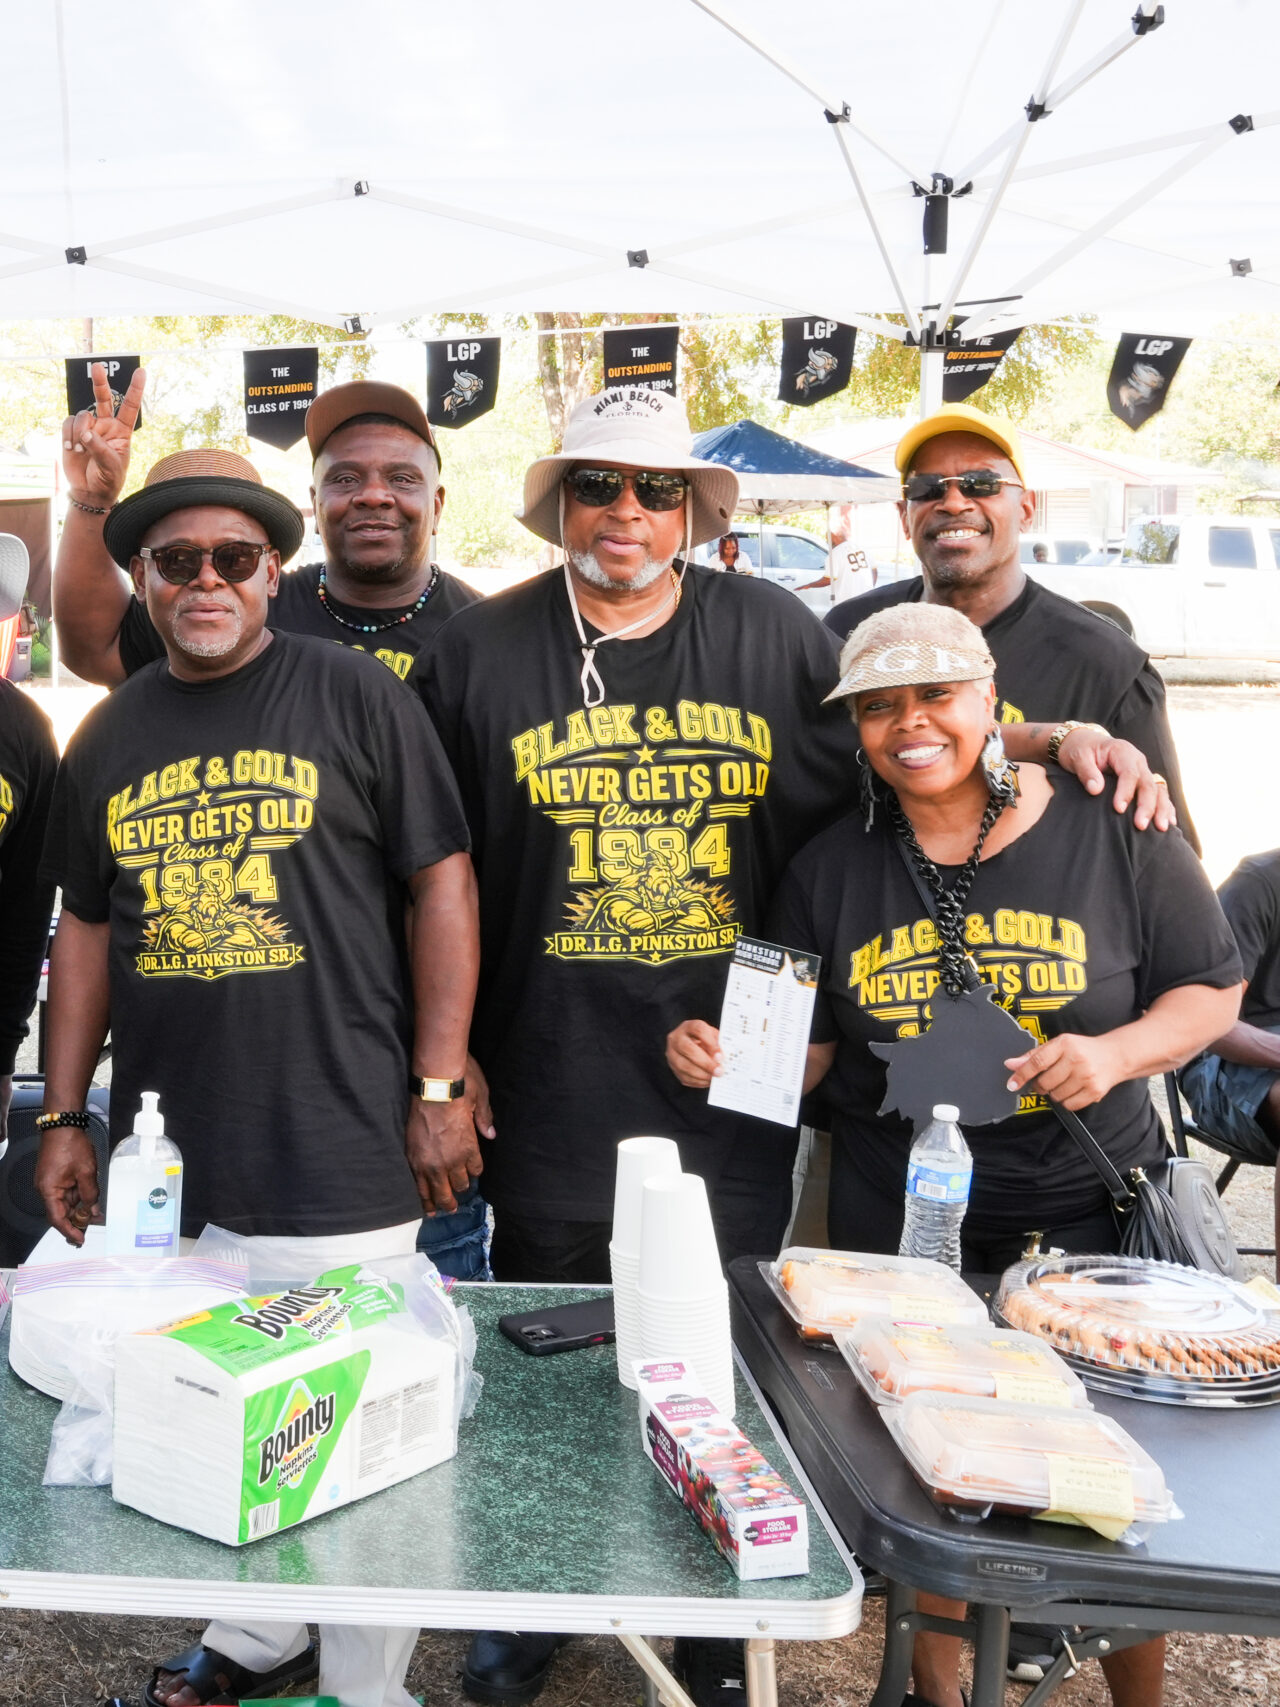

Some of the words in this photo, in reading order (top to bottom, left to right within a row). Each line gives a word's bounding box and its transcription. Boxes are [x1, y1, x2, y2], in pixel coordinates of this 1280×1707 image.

[803, 320, 838, 340] LGP
[447, 342, 481, 362] LGP
[631, 346, 650, 358] THE
[1134, 338, 1173, 356] LGP
[271, 367, 290, 377] THE
[608, 361, 672, 378] OUTSTANDING
[248, 382, 313, 396] OUTSTANDING
[651, 379, 673, 390] 1984
[247, 402, 277, 415] CLASS
[278, 401, 291, 411] OF
[593, 391, 623, 416] MIAMI
[629, 391, 664, 412] BEACH
[847, 550, 868, 572] 93
[512, 704, 639, 783] BLACK
[645, 706, 678, 742] &
[677, 699, 772, 763] GOLD
[107, 755, 201, 836] BLACK
[205, 756, 230, 787] &
[233, 749, 319, 801] GOLD
[528, 767, 621, 806] NEVER
[628, 763, 712, 803] GETS
[719, 761, 769, 797] OLD
[599, 803, 667, 826] Class
[672, 799, 704, 827] of
[109, 814, 185, 855] NEVER
[190, 803, 254, 840] GETS
[259, 798, 314, 830] OLD
[163, 842, 219, 863] Class
[222, 833, 246, 858] of
[568, 823, 731, 883] 1984
[138, 854, 280, 913] 1984
[630, 932, 718, 952] PINKSTON
[849, 918, 942, 988] BLAC
[965, 912, 993, 944] &
[993, 908, 1087, 964] GOLD
[187, 950, 267, 968] PINKSTON
[858, 972, 941, 1007] NEVER
[1028, 962, 1087, 993] OLD
[234, 1287, 344, 1340] Bounty
[301, 1304, 336, 1331] Napkins
[311, 1303, 352, 1340] Serviettes
[259, 1393, 335, 1486] Bounty
[276, 1452, 318, 1492] Serviettes
[279, 1443, 314, 1477] Napkins
[762, 1525, 791, 1534] STORAGE
[767, 1520, 786, 1528] FOOD
[985, 1562, 1038, 1576] LIFETIME
